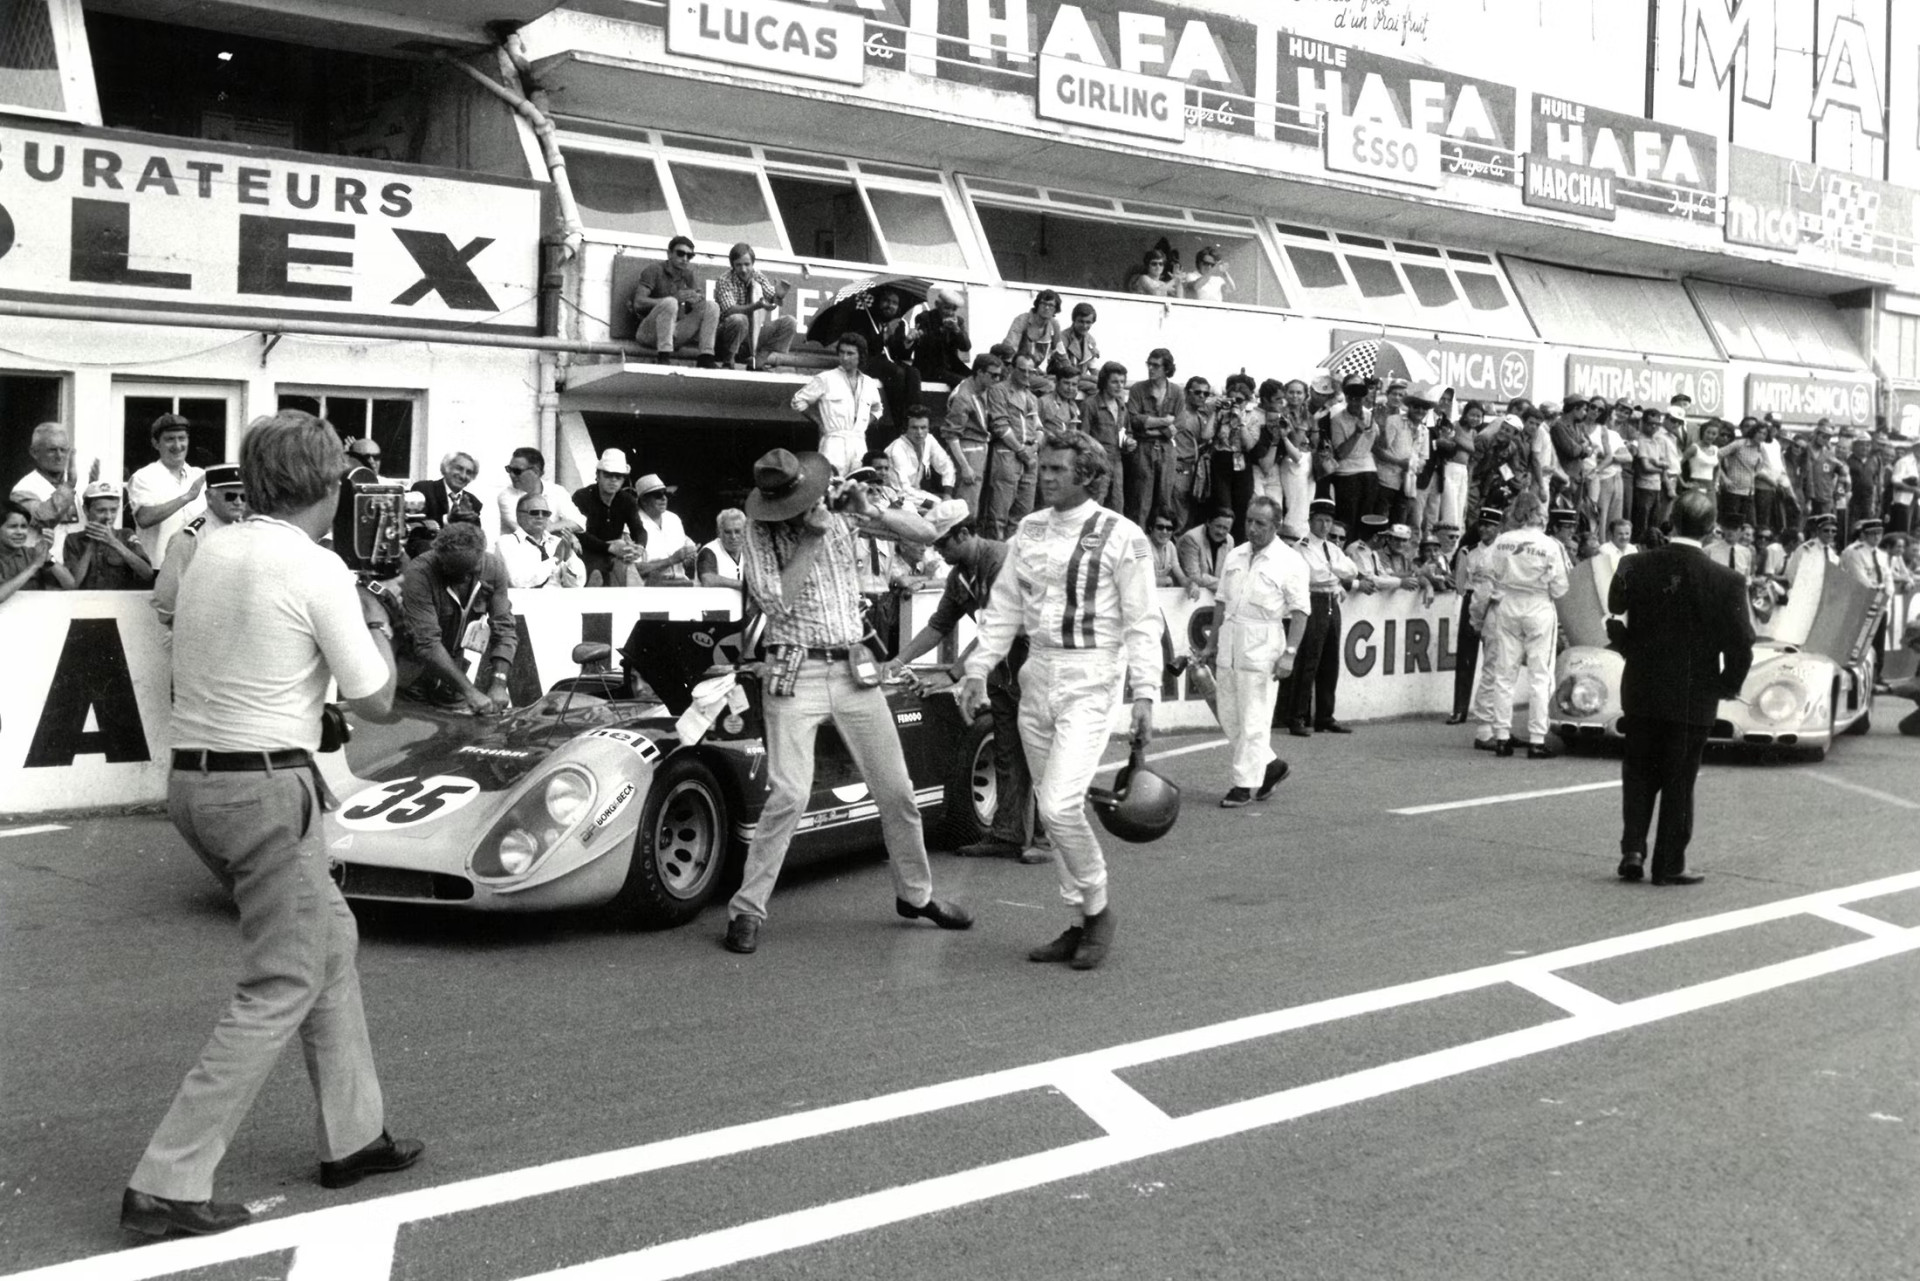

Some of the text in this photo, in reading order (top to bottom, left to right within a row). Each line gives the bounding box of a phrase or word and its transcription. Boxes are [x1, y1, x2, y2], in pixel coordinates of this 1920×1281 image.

[699, 3, 838, 60] LUCAS
[967, 0, 1231, 83] HAFA
[1289, 36, 1347, 68] HUILE
[1056, 74, 1168, 121] GIRLING
[1297, 66, 1497, 140] HAFA
[1540, 97, 1586, 123] HUILE
[1352, 124, 1418, 172] ESSO
[1546, 122, 1701, 184] HAFA
[0, 140, 413, 218] URATEURS
[1529, 162, 1616, 211] MARCHAL
[1728, 196, 1799, 246] TRICO
[0, 196, 501, 312] LEX
[1503, 360, 1525, 390] 32
[1702, 377, 1717, 405] 31
[343, 777, 475, 824] 35
[616, 783, 634, 804] BECK
